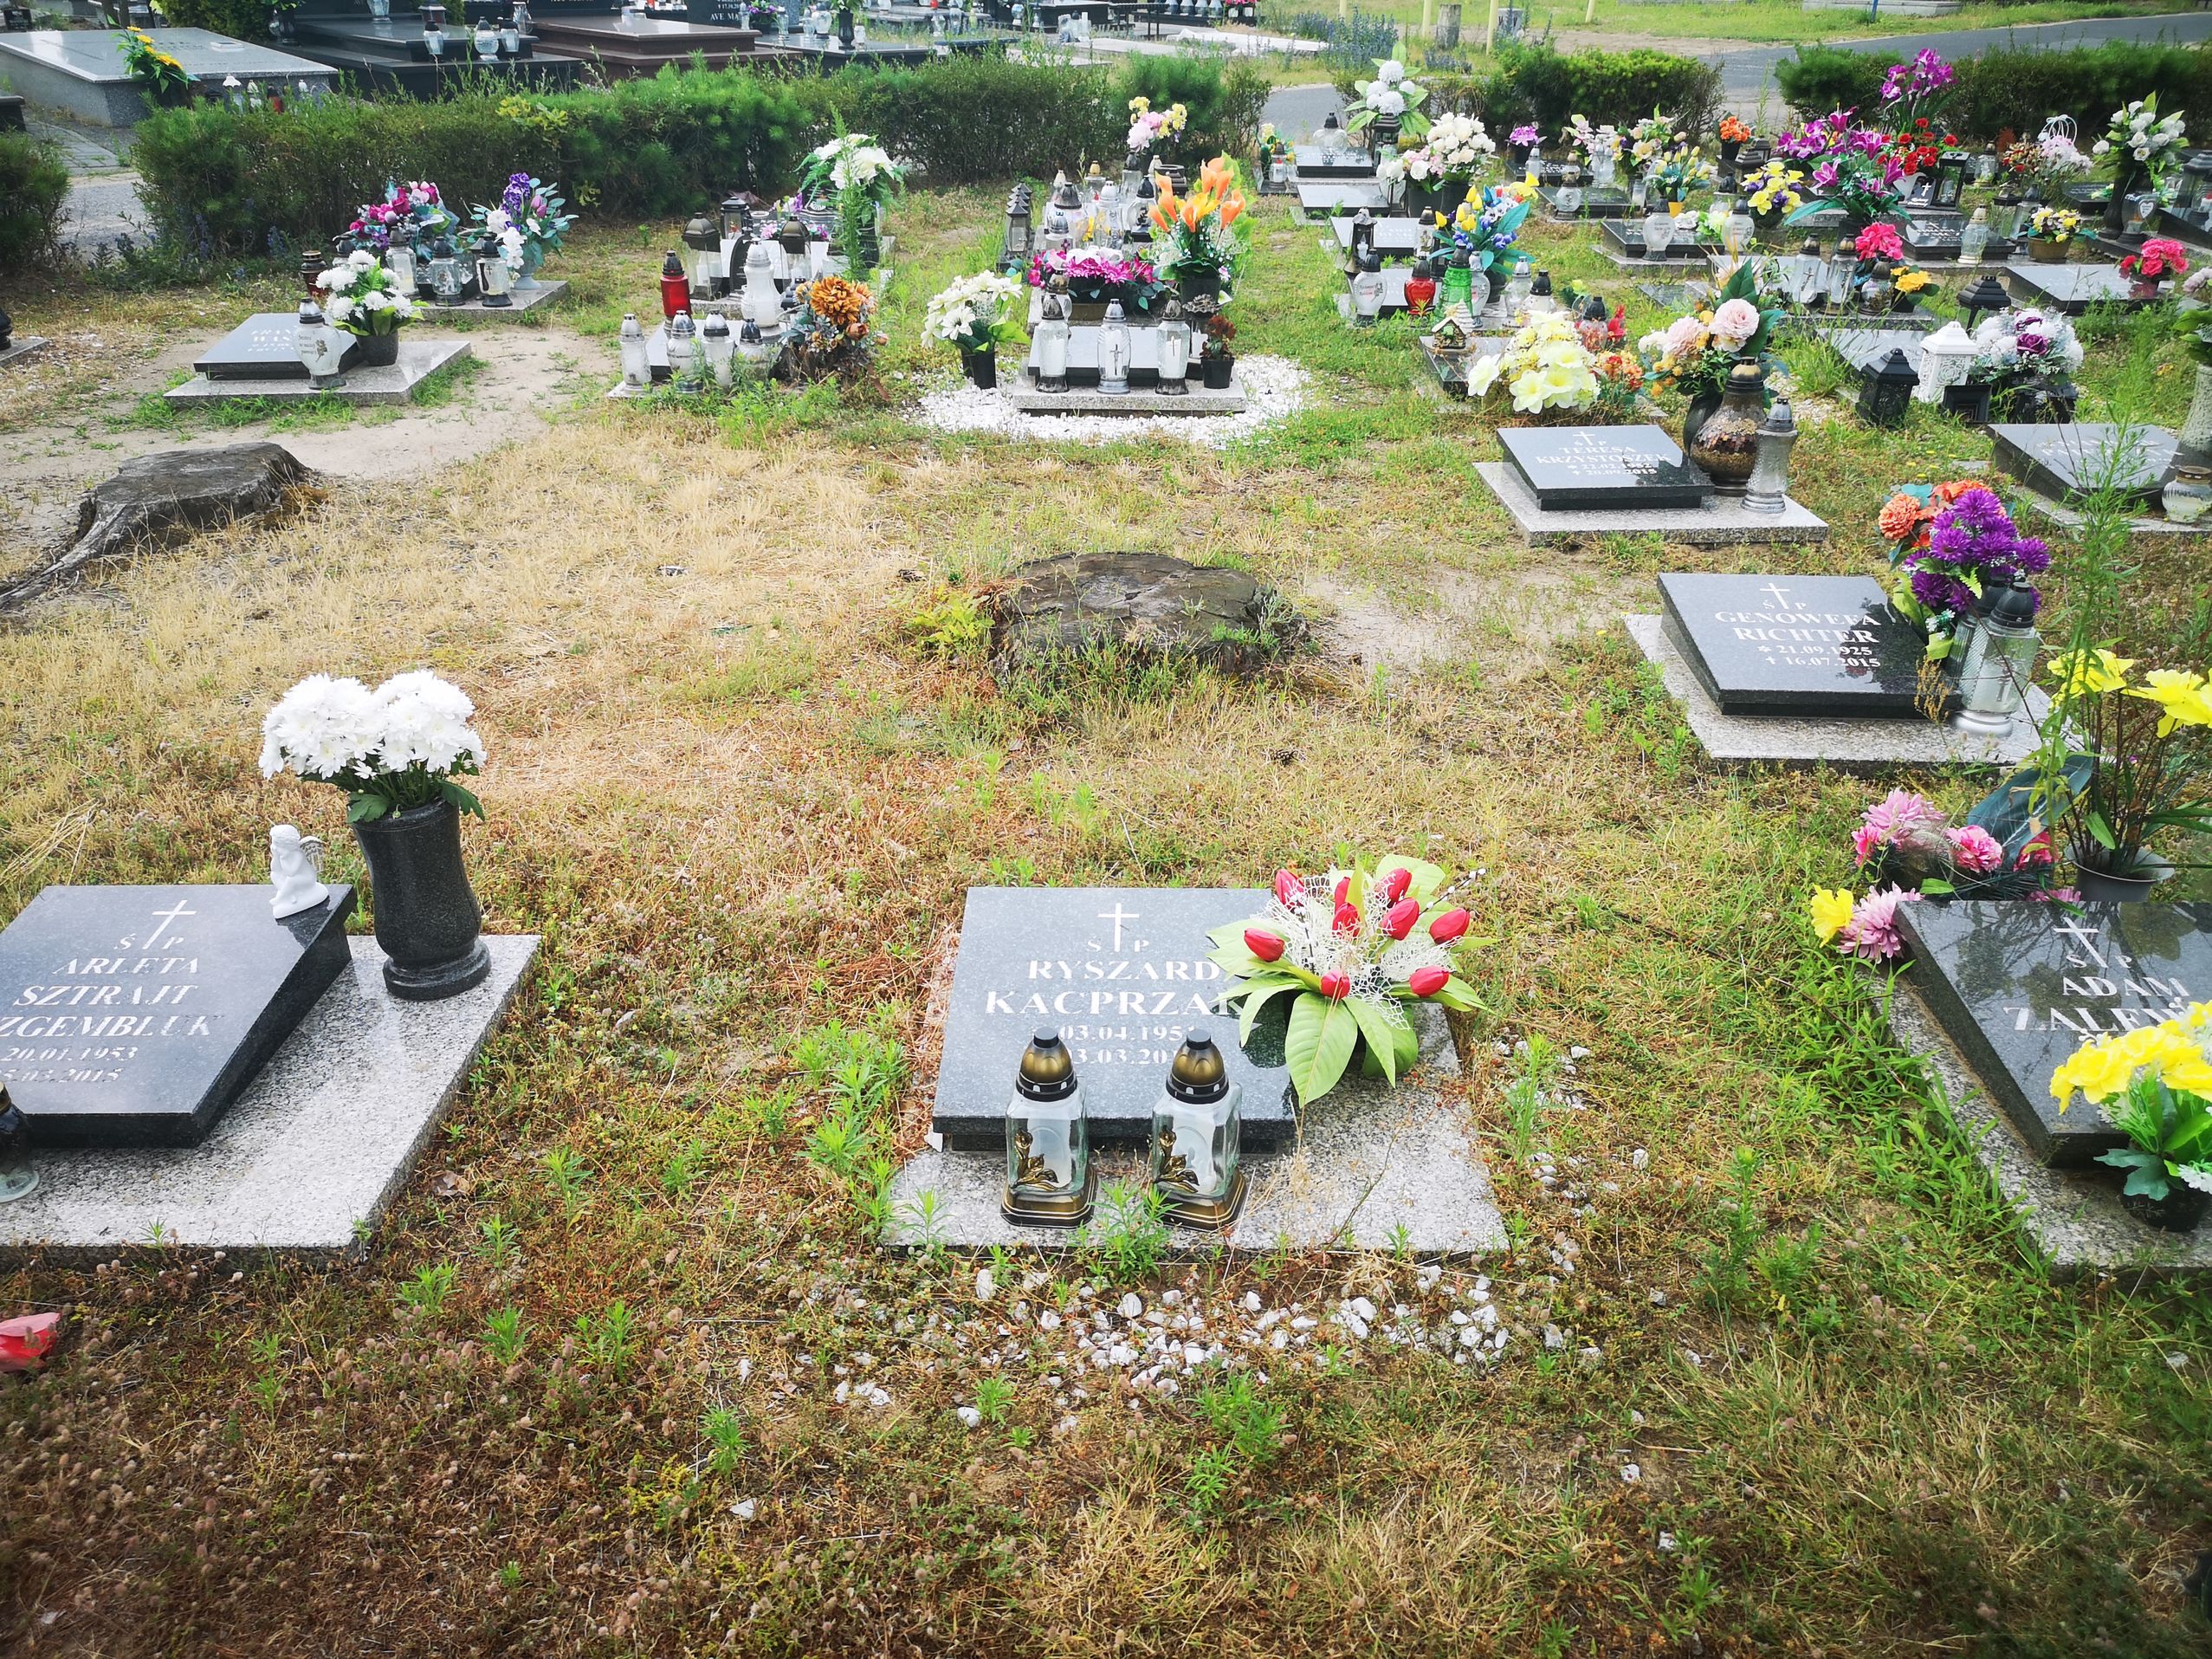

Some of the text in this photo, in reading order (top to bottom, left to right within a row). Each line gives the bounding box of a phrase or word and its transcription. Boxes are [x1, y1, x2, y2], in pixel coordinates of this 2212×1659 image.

[1558, 446, 1637, 455] TERESA
[1535, 453, 1672, 464] KRZYSTOSZEK
[1715, 611, 1882, 625] GENOWEFA
[1732, 627, 1880, 643] RICHTER
[1784, 656, 1882, 668] 16.07.2015
[162, 936, 184, 949] P
[1134, 939, 1149, 952] P
[52, 957, 199, 975] ARLETA
[1027, 959, 1221, 980] RYSZARD
[2115, 955, 2133, 969] P
[2062, 976, 2190, 996] ADAM
[13, 985, 199, 1006] SZTRAJT
[1058, 1024, 1196, 1041] 03.04.195
[0, 1067, 125, 1083] 5.03.2015
